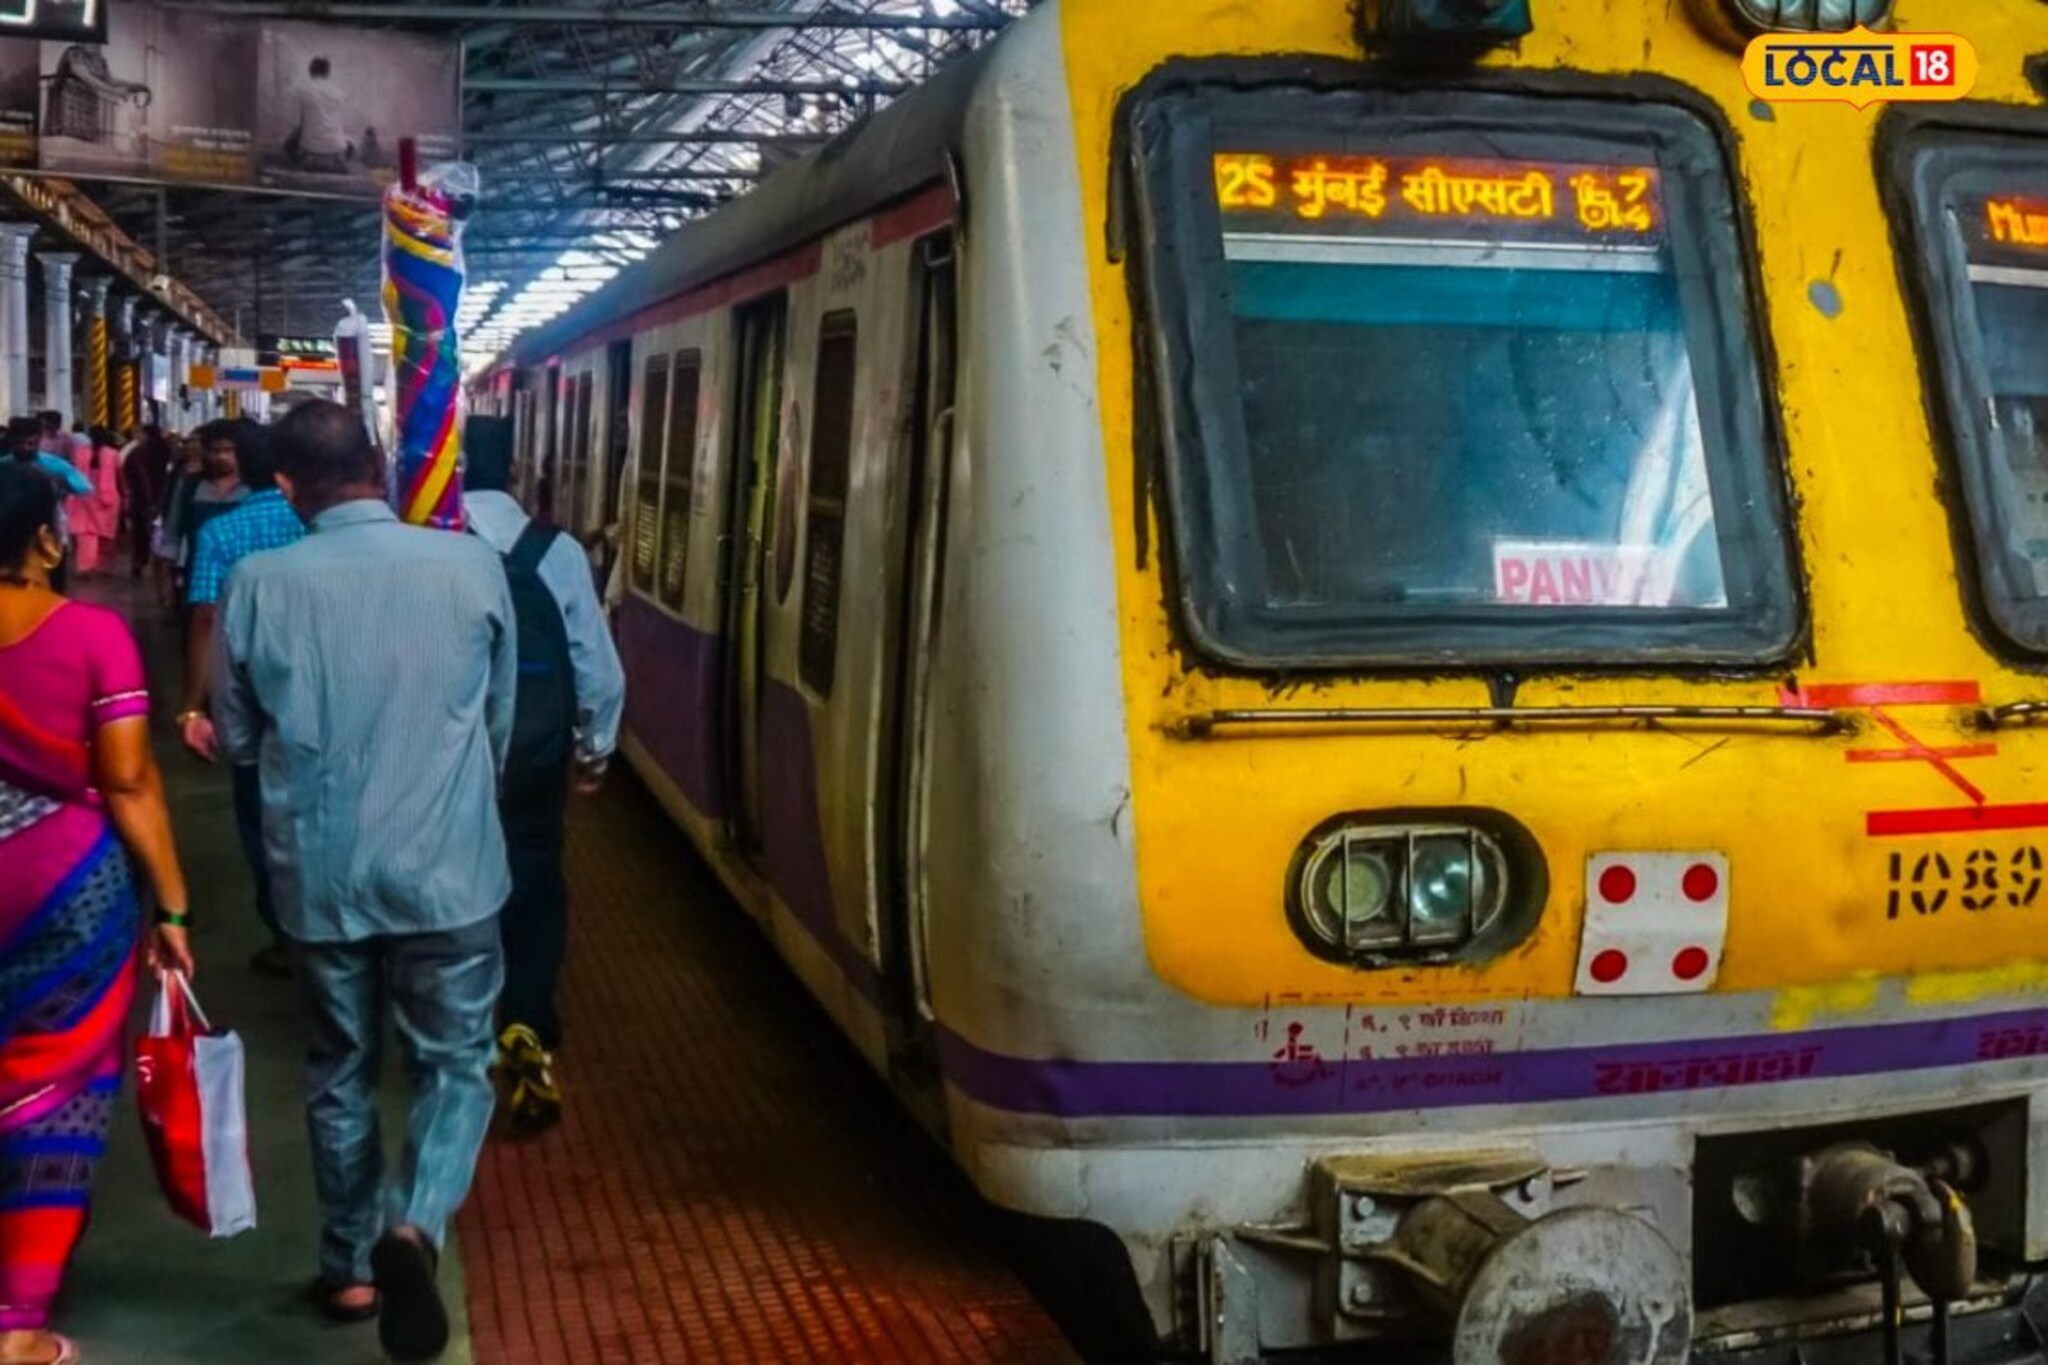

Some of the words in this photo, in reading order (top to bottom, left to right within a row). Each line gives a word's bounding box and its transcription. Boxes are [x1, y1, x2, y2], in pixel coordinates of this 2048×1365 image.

[1293, 162, 1386, 217] मुंबई
[1402, 167, 1553, 217] सीएसटी
[1887, 846, 2042, 920] 1089
